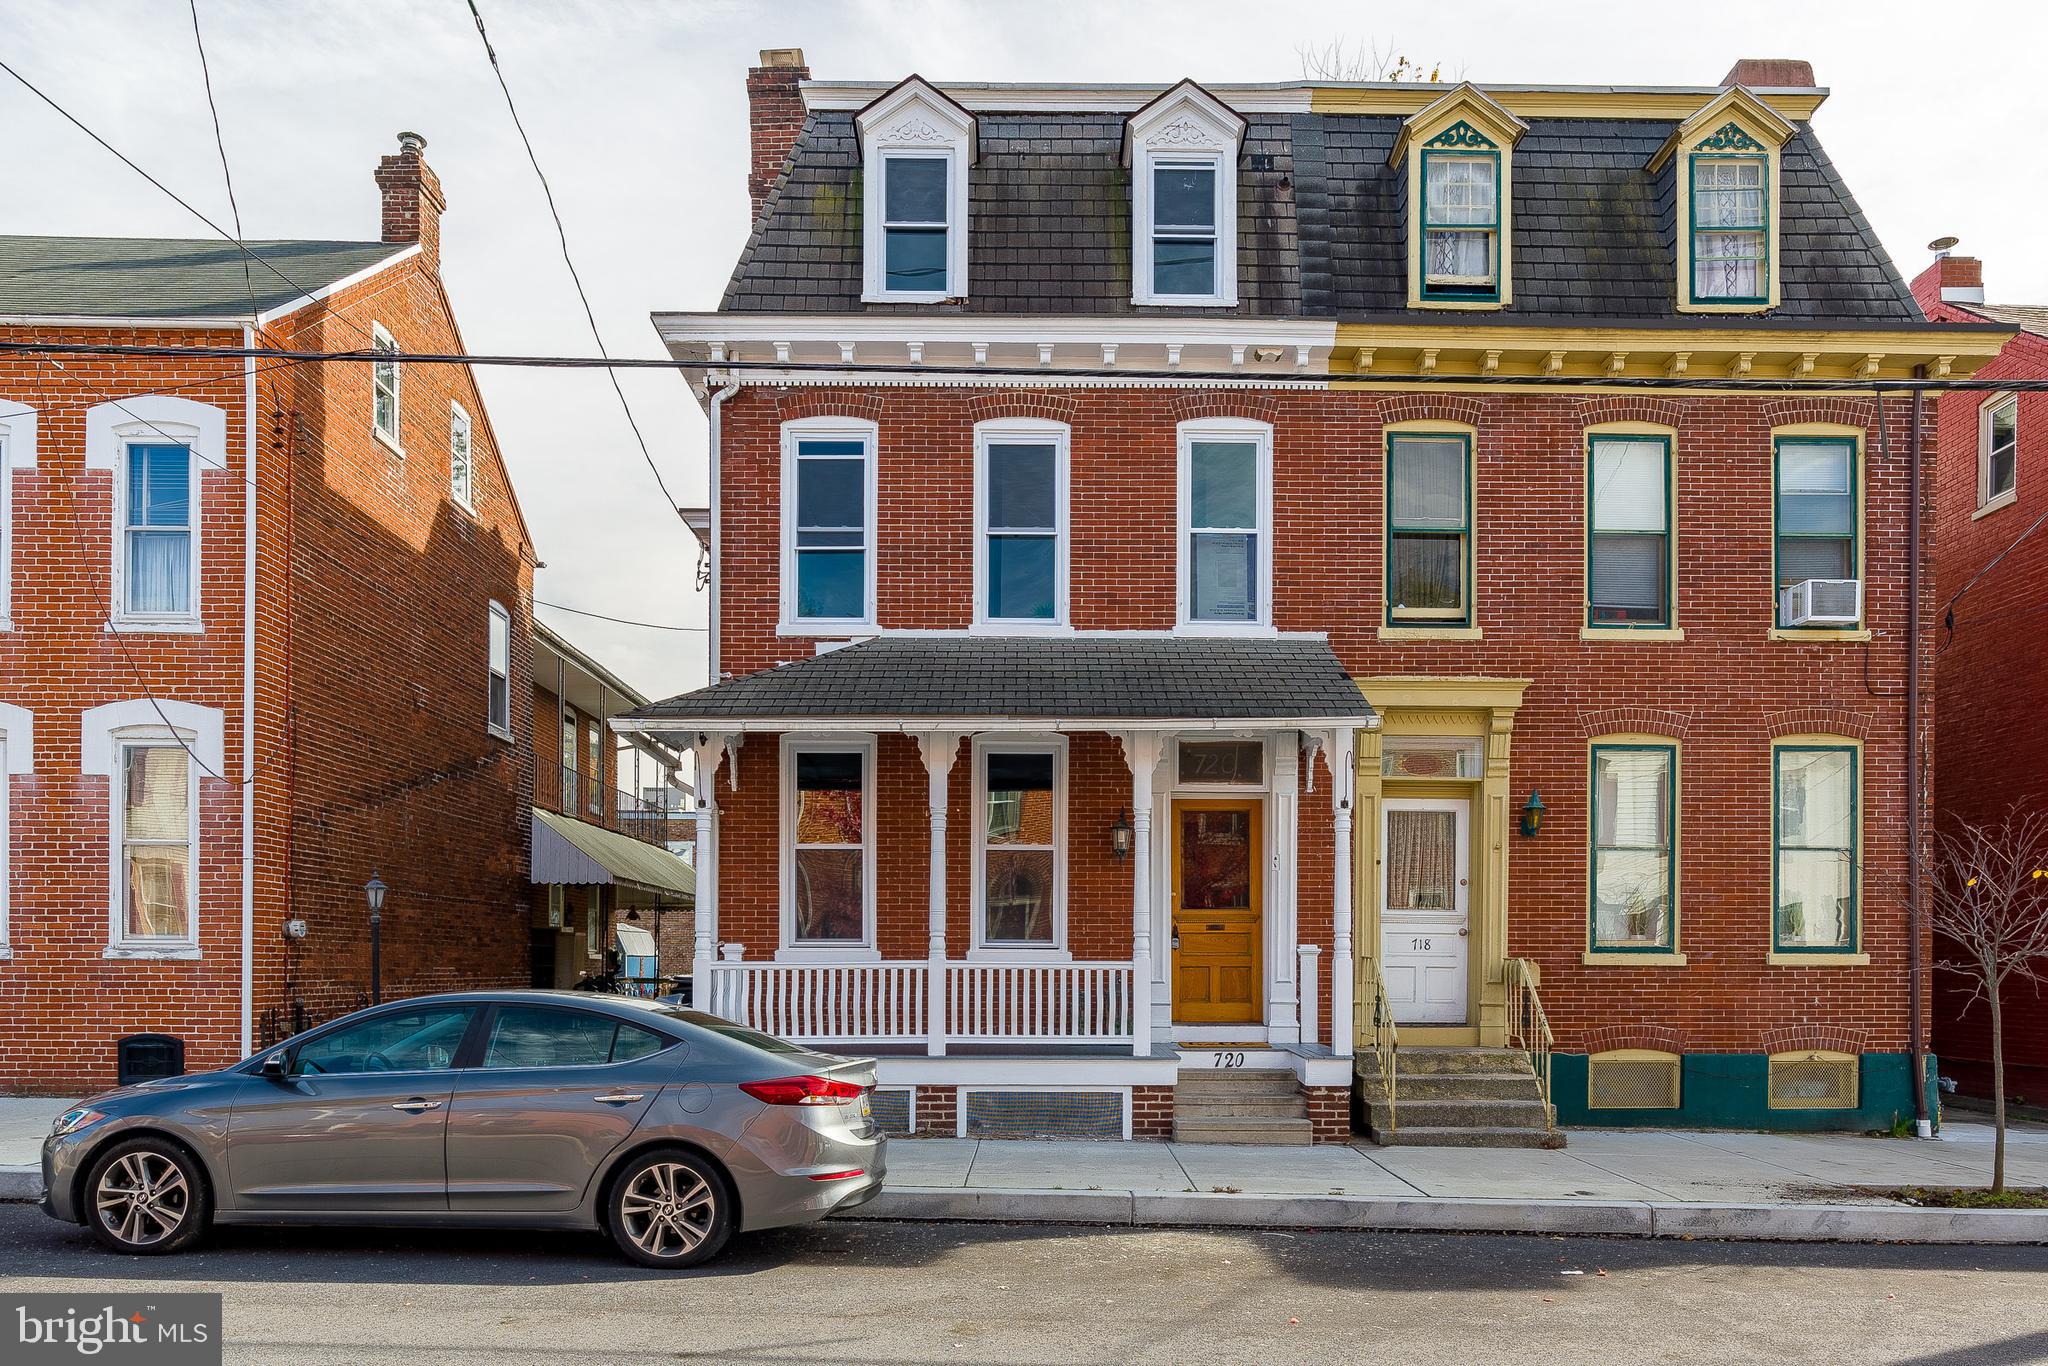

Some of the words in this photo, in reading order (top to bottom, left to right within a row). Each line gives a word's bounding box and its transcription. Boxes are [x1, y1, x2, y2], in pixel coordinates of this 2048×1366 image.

[1193, 752, 1235, 775] 720
[1411, 938, 1432, 951] 718
[1213, 1052, 1245, 1068] 720
